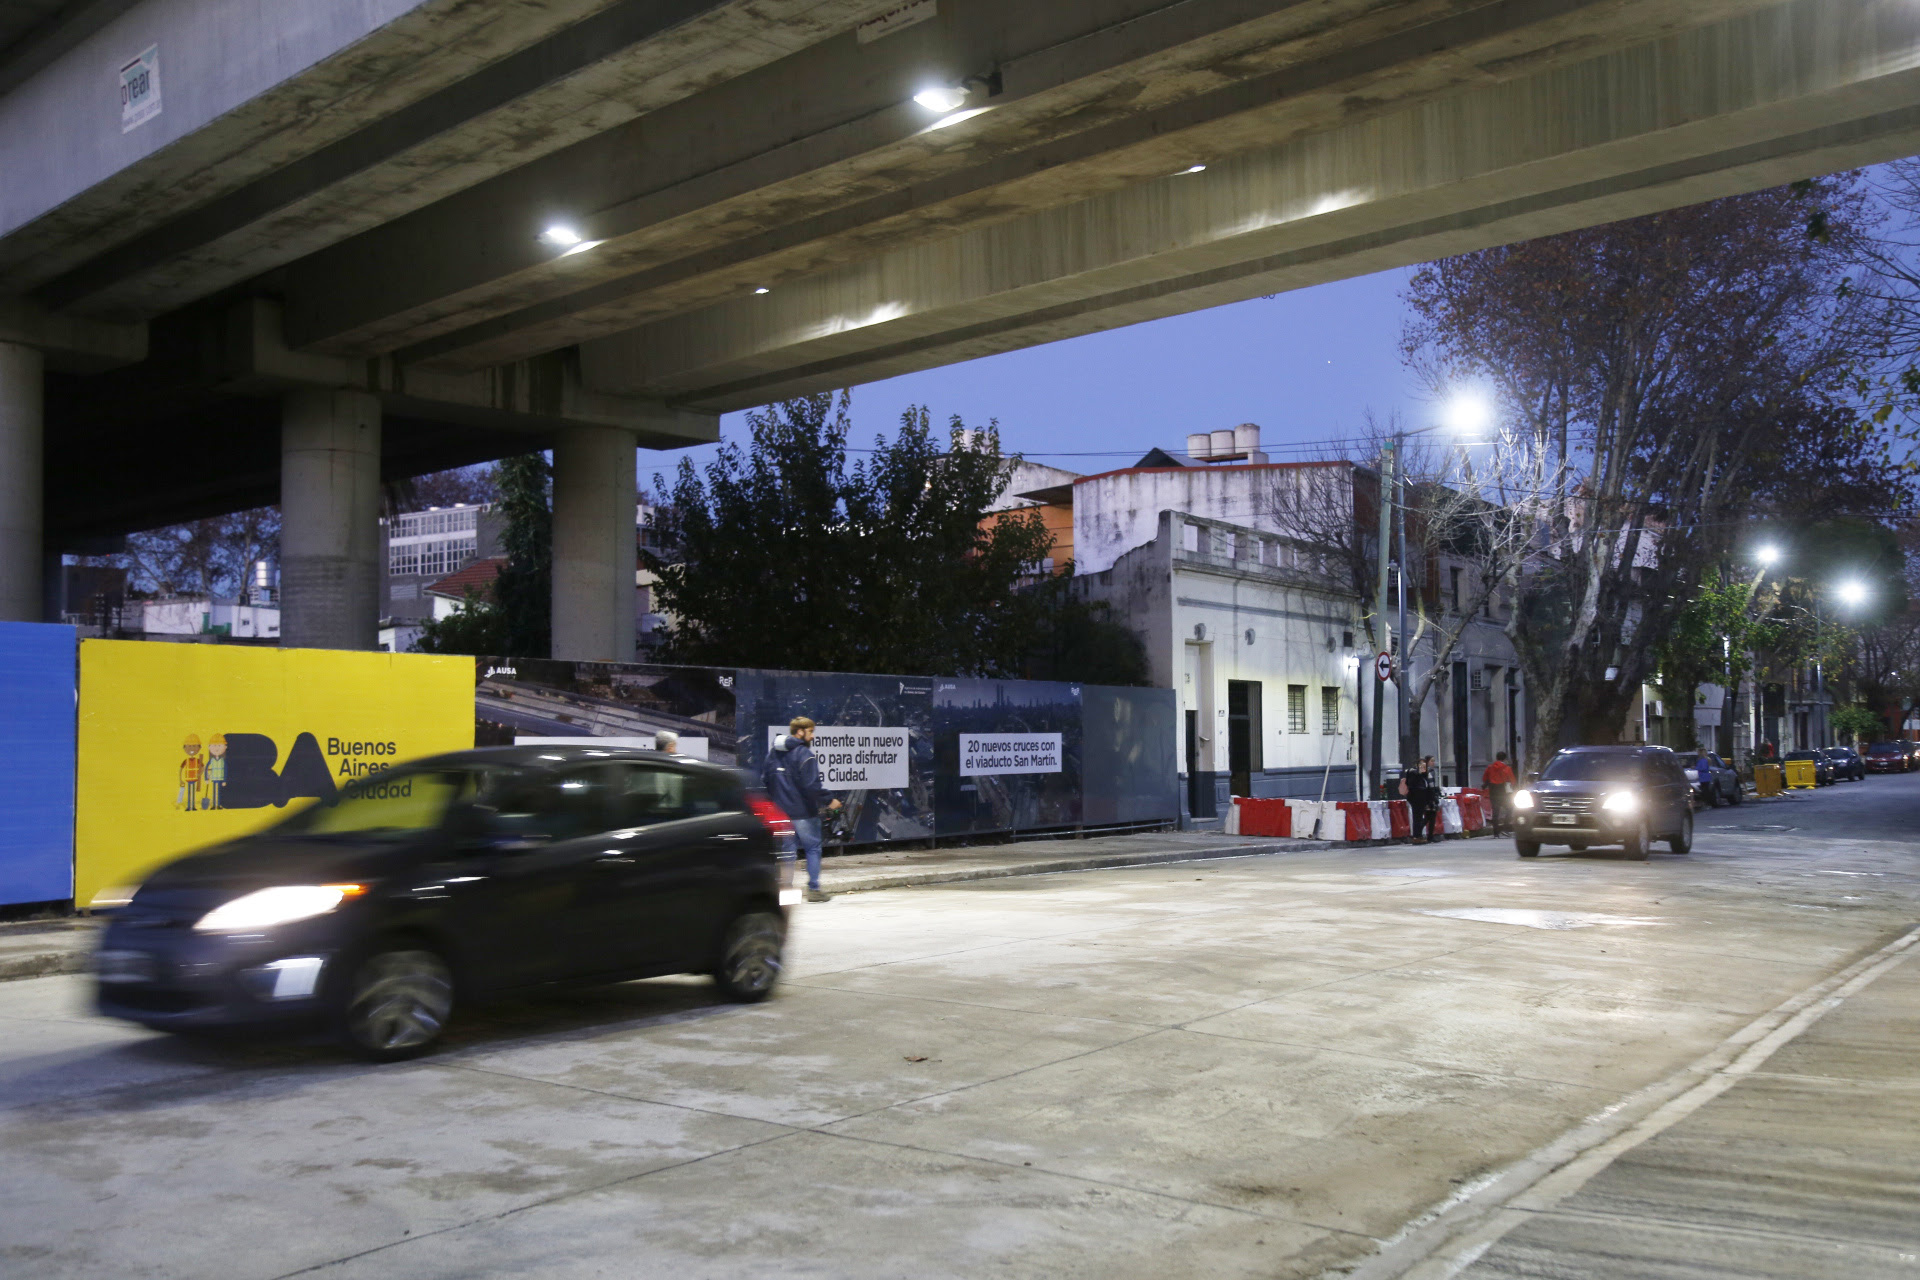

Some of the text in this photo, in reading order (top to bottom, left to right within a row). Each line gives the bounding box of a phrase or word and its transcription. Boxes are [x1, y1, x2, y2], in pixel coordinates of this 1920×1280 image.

[496, 667, 517, 675] AUSA
[327, 738, 396, 756] Buenos
[857, 735, 871, 748] un
[873, 735, 904, 748] nuevo
[968, 740, 1056, 753] 20 nuevos cruces con
[828, 752, 853, 768] para
[855, 750, 898, 765] disfrutar
[965, 753, 1058, 769] el viaducto San Martín.
[339, 758, 390, 777] Aires
[828, 767, 868, 782] Ciudad.
